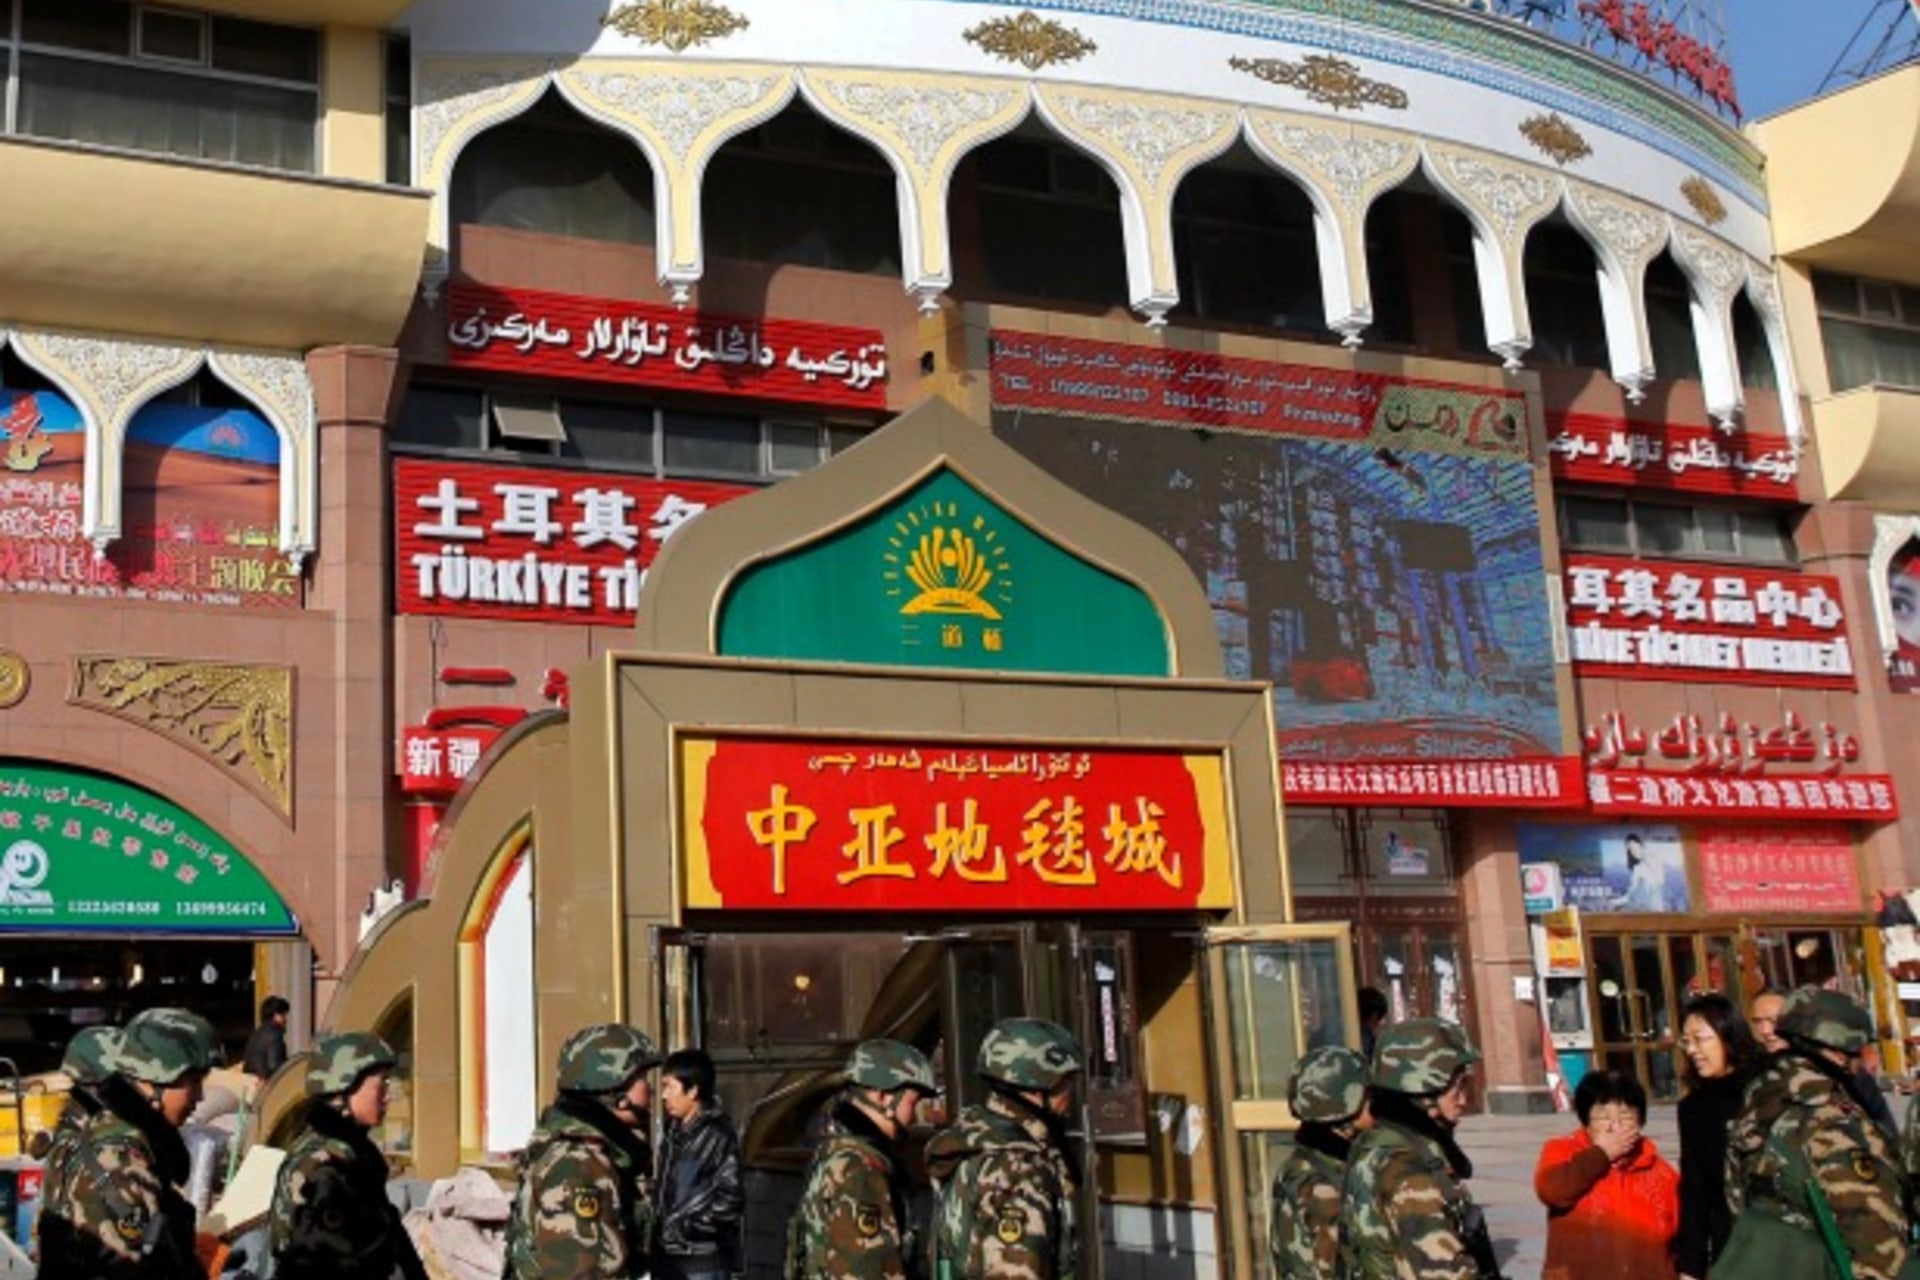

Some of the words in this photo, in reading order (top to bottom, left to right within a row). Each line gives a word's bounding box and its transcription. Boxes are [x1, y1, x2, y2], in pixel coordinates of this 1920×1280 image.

[412, 544, 590, 609] TÜRKİYE
[598, 552, 650, 609] Tİ
[746, 783, 1184, 895] 中亚地毯城
